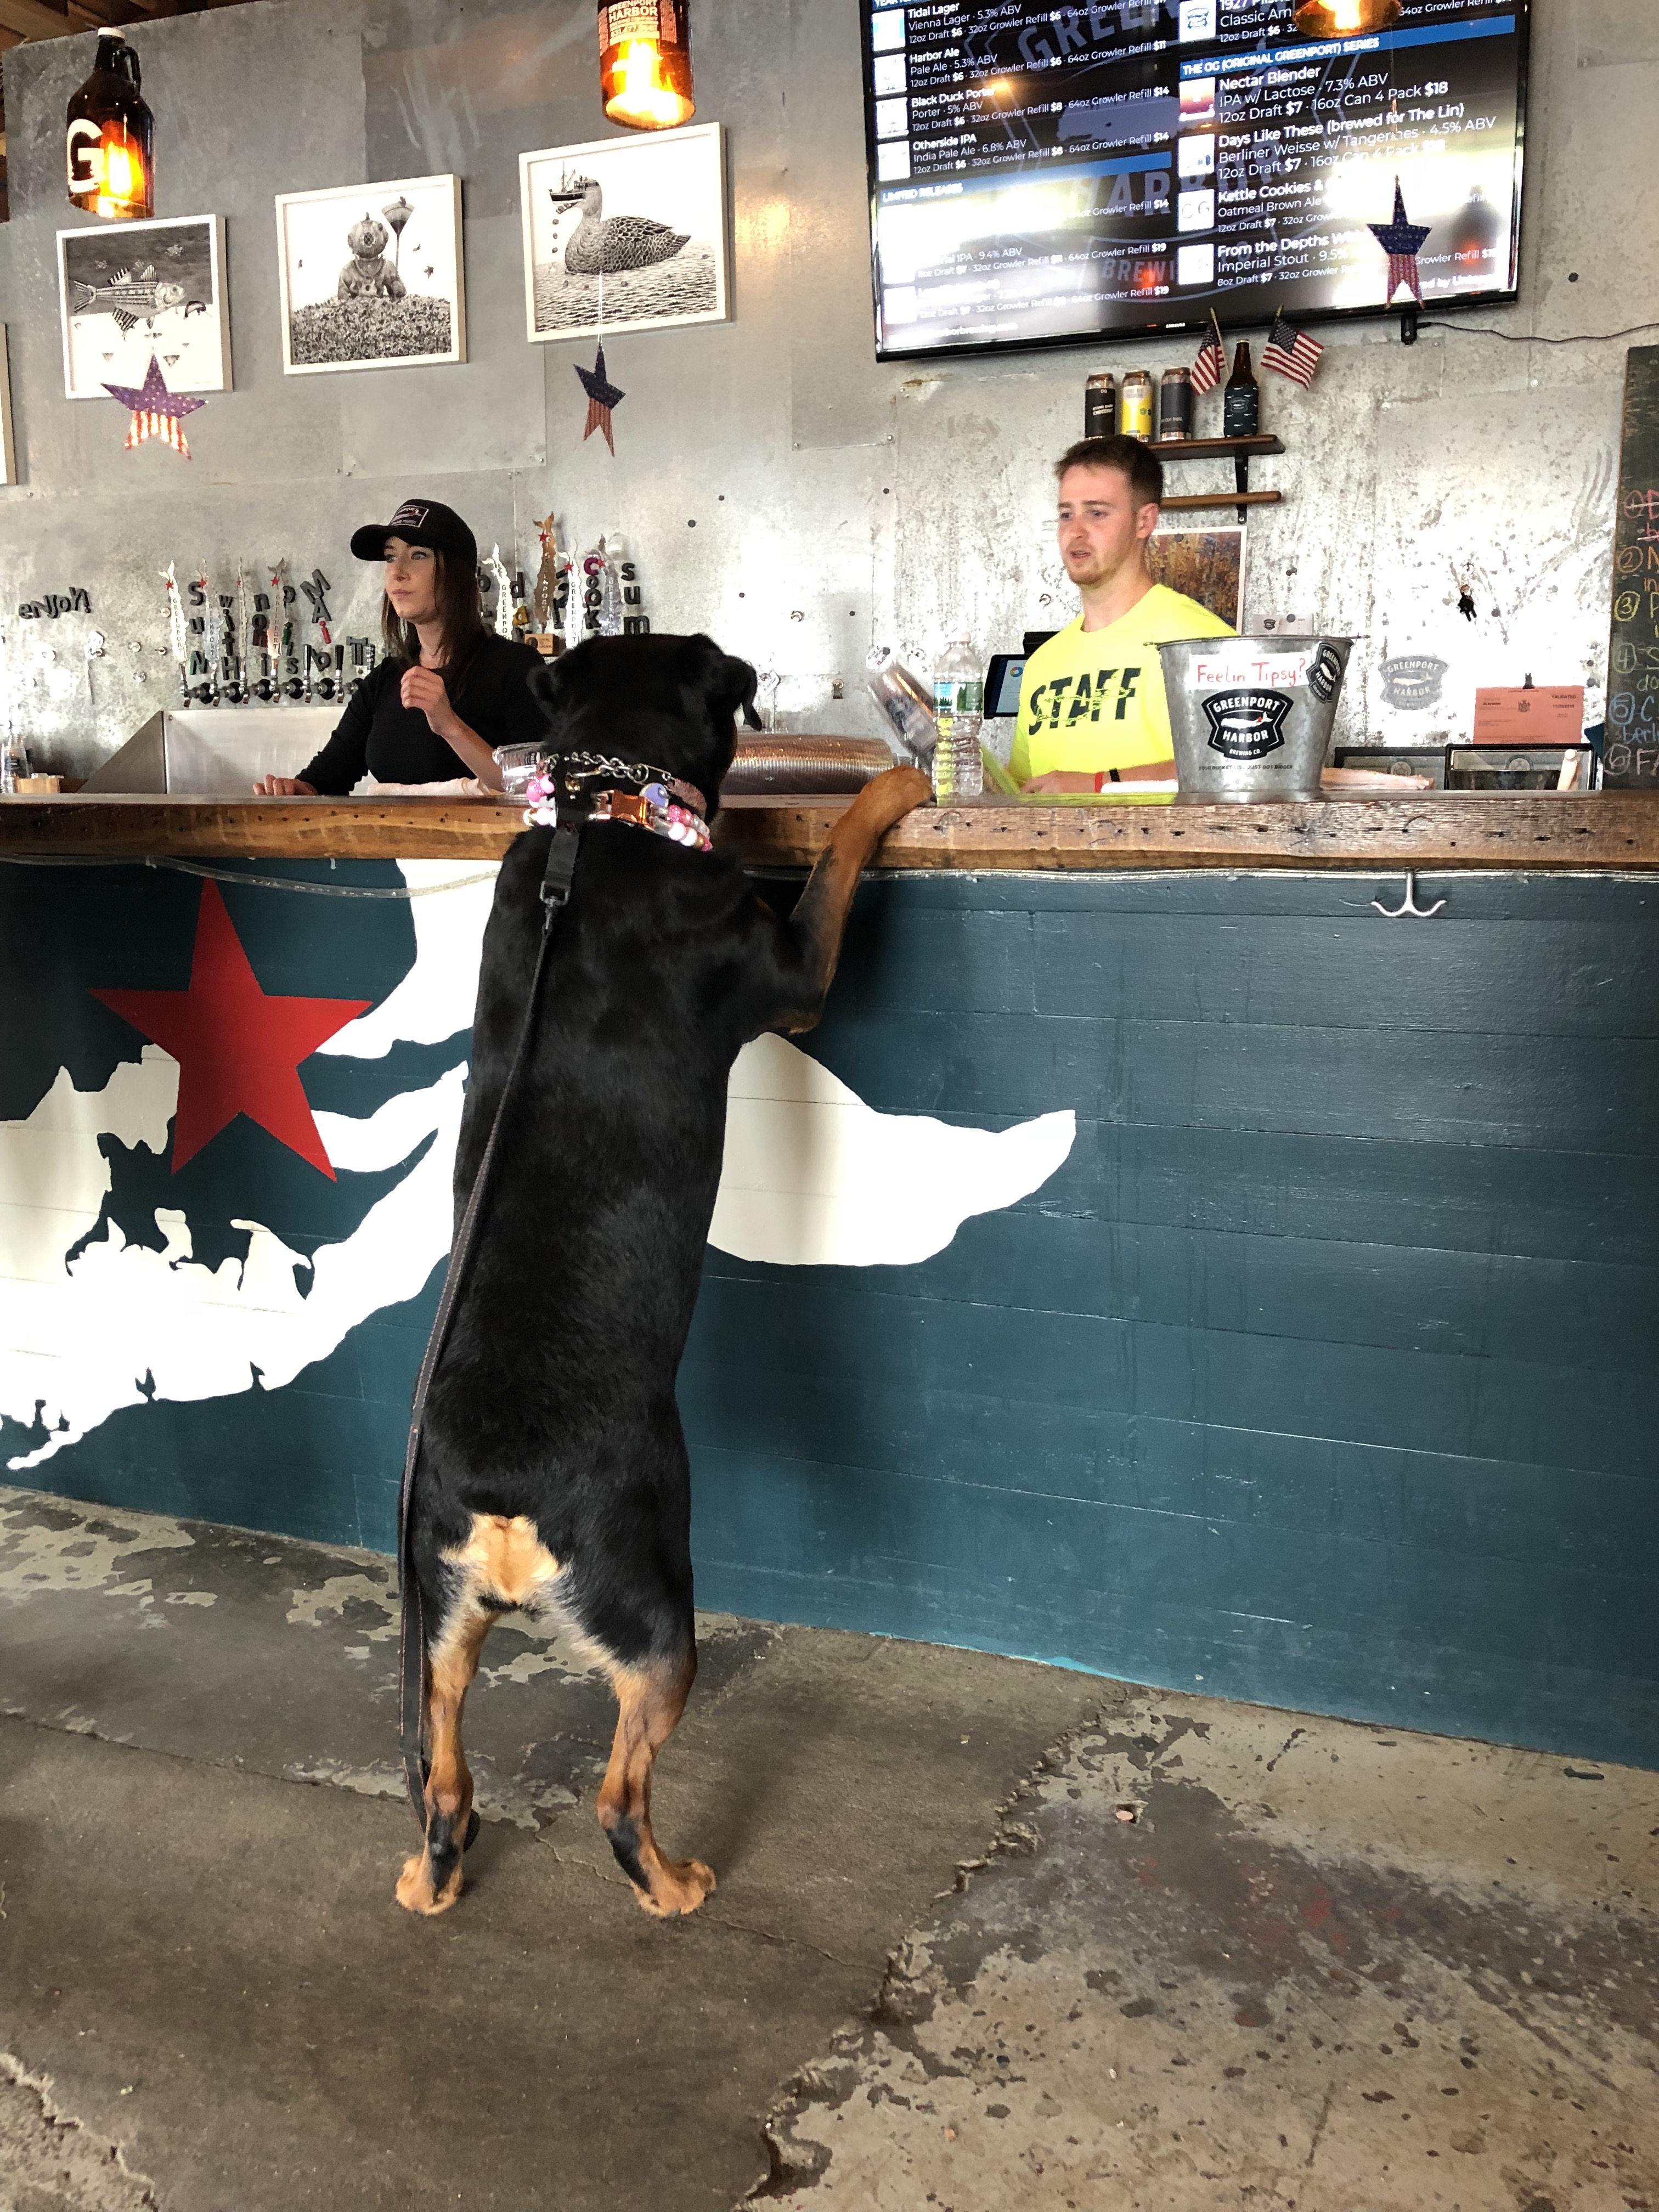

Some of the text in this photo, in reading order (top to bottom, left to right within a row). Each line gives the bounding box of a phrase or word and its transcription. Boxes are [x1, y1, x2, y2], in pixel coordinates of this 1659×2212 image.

[608, 0, 657, 13] GREENPORT
[908, 4, 960, 19] Tidal Lager
[1219, 0, 1247, 10] 1927
[1425, 1, 1464, 13] Growler
[609, 6, 658, 23] HARBOR
[909, 4, 1021, 31] Vienna Lager 5.3% ABV
[1220, 12, 1264, 27] Classic
[951, 12, 1061, 38] $6 $6
[1220, 26, 1279, 43] 12oz Draft $6
[910, 47, 960, 64] Harbor Ale
[911, 54, 997, 75] Pale Ale 5.3% ABV
[952, 41, 1166, 82] $6 $6 $11
[1183, 39, 1379, 75] THE OG (ORIGINAL GREENPORT) SERIES
[1220, 68, 1321, 91] Nectar Blender
[912, 91, 963, 108] Black Duck
[1220, 74, 1389, 108] IPA w/ Lactose 7.3% ABV
[912, 101, 983, 119] Porter 5% ABV
[954, 86, 1170, 126] $6 $14
[1219, 82, 1448, 124] 12oz Draft $7 16oz Can 4 Pack $18
[1219, 103, 1464, 148] Days Like These (brewed for The Lin)
[913, 133, 977, 151] Otherside IPA
[1220, 117, 1497, 163] Berliner Weisse w/ 4.5% ABV
[914, 139, 1027, 162] India Pale Ale 6.8% ABV
[914, 132, 1169, 174] 12oz Draft $6 32oz Growler Refill 64oz Growler Refill $14
[1219, 167, 1245, 179] 12oz
[1249, 161, 1280, 175] Draft
[1285, 159, 1301, 172] $7
[1311, 156, 1339, 167] 16oz
[1386, 142, 1418, 157] Pack
[883, 189, 917, 202] LIMITED
[1218, 182, 1311, 203] Kettle Cookies
[1093, 199, 1169, 216] Growler Refill $14
[1218, 196, 1321, 217] Oatmeal Brown Ale
[1218, 217, 1303, 232] 12oz Draft $7 32oz
[957, 252, 972, 262] IPA
[1002, 246, 1023, 256] ABV
[1152, 243, 1166, 253] $19
[1218, 235, 1328, 257] From the Depths
[1454, 249, 1479, 260] Refill
[1218, 252, 1309, 273] Imperial Stout
[1236, 274, 1258, 284] Draft
[1261, 273, 1273, 283] $7
[1279, 272, 1299, 280] 32oz
[1302, 267, 1338, 278] Growler
[1154, 286, 1169, 296] $19
[173, 598, 182, 653] GREENPORT
[1198, 657, 1306, 687] Feelin Tipsy?
[1387, 661, 1440, 673] GREENPORT
[1393, 686, 1431, 697] HARBOR
[1028, 667, 1141, 736] STAFF
[1212, 696, 1281, 713] GREENPORT
[1222, 729, 1269, 743] HARBOR
